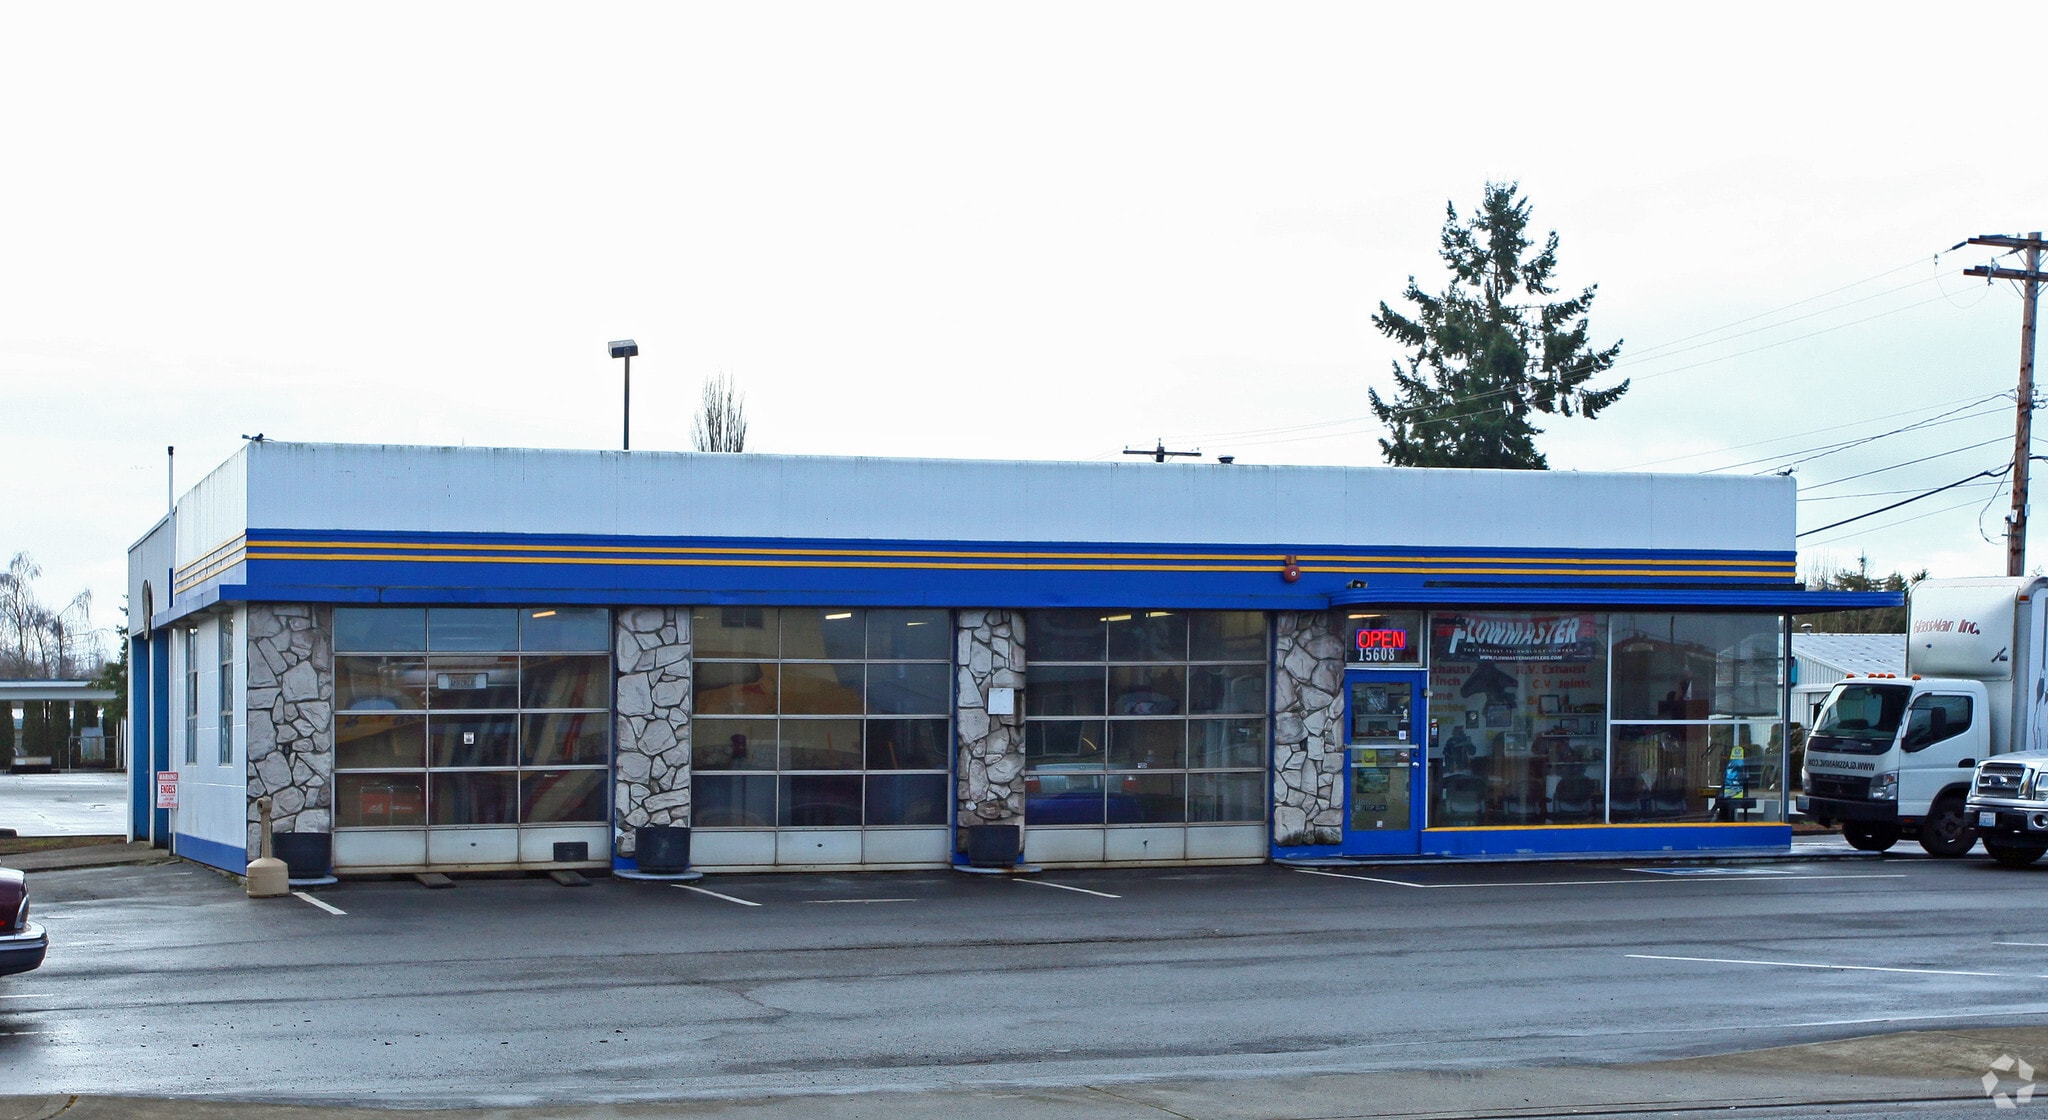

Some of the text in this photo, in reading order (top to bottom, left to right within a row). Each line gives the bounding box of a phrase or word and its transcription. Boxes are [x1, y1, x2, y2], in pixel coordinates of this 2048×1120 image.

[1448, 616, 1580, 654] FLOWMASTER
[1957, 619, 1981, 635] Inc.
[1358, 630, 1404, 649] OPEN
[1359, 647, 1395, 661] 15608
[1542, 664, 1587, 674] Exhaust
